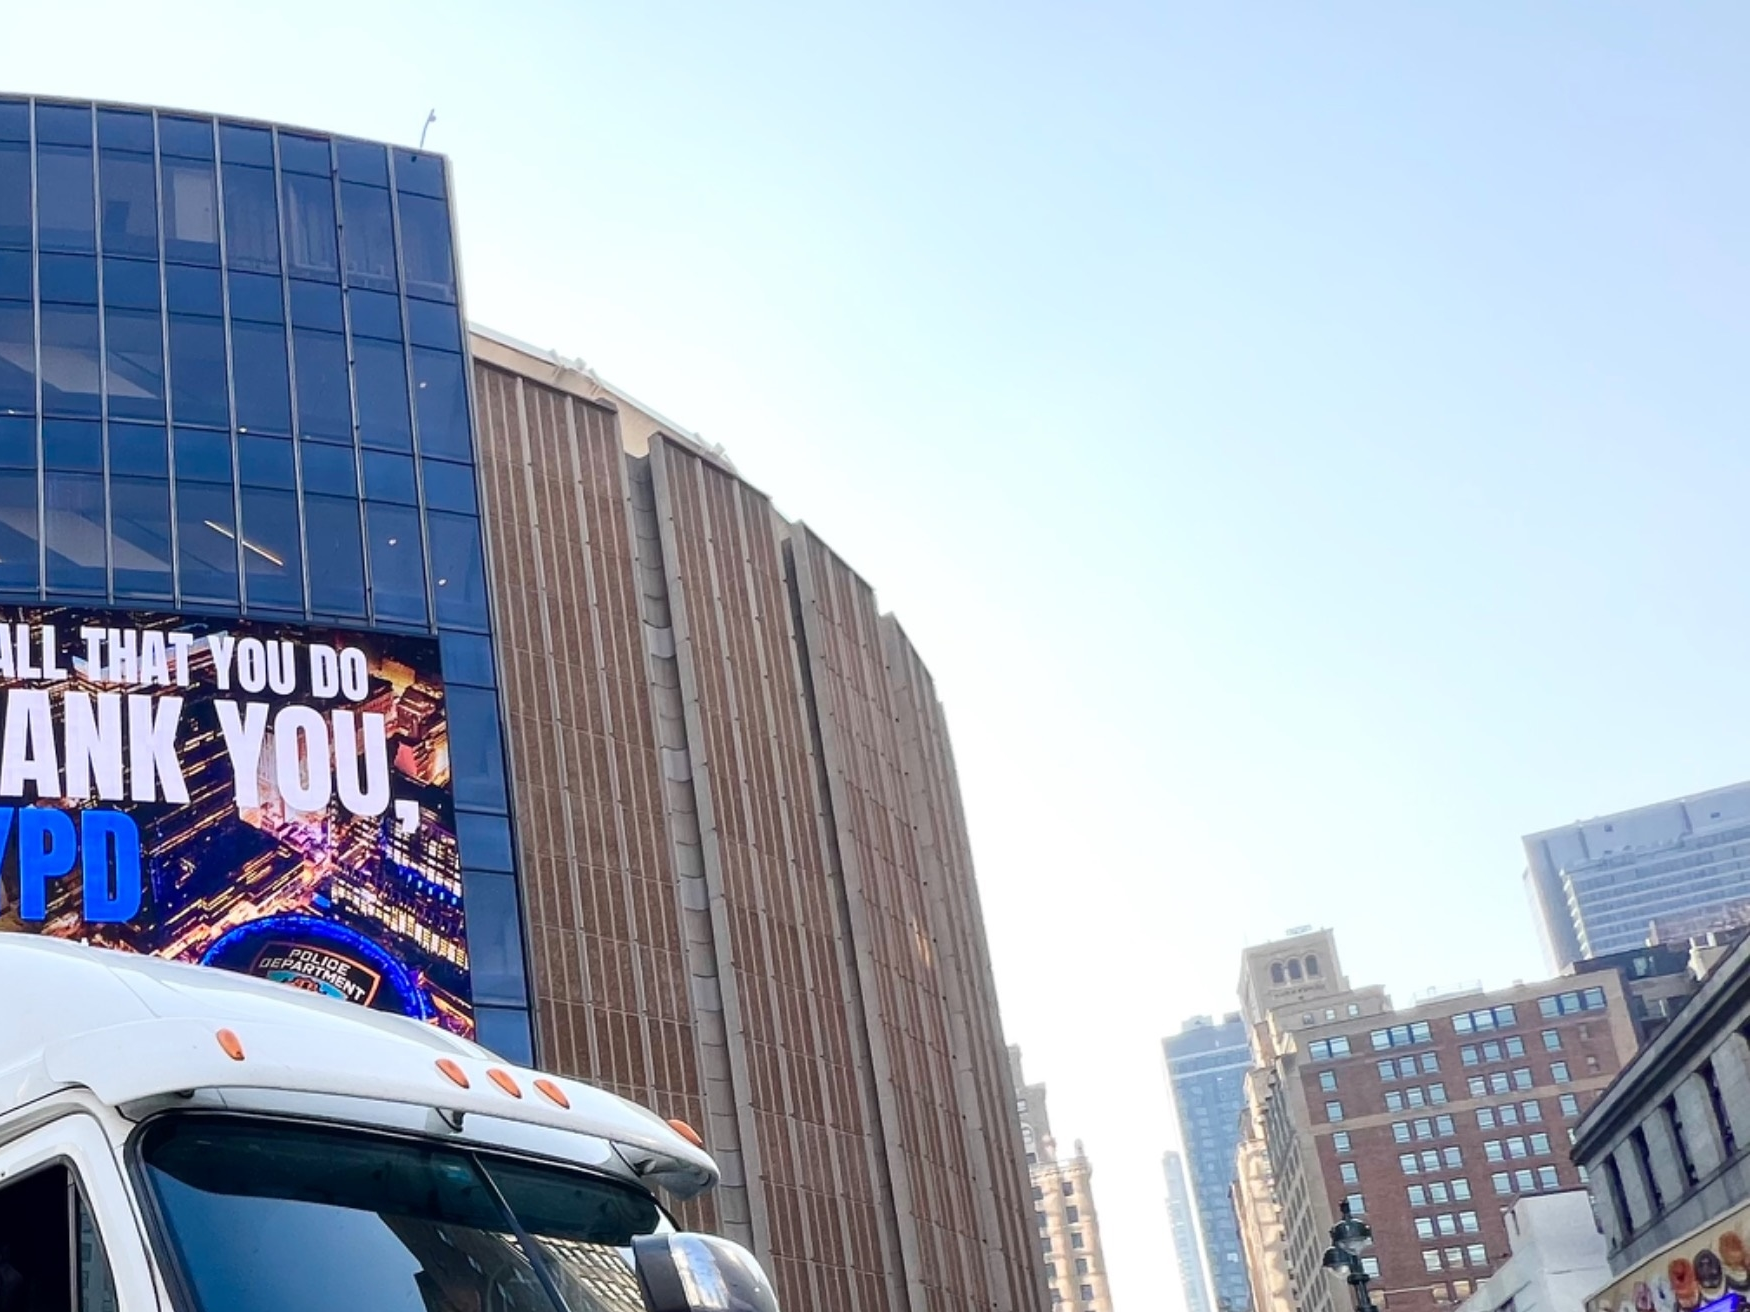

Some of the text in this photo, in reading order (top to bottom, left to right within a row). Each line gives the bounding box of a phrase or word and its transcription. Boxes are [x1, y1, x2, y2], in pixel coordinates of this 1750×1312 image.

[80, 626, 194, 688] THAT
[209, 634, 296, 696] YOU
[311, 644, 369, 702] DO
[213, 698, 421, 835] YOU,
[259, 957, 366, 1001] DEPARTMENT
[289, 949, 351, 977] POLICE
